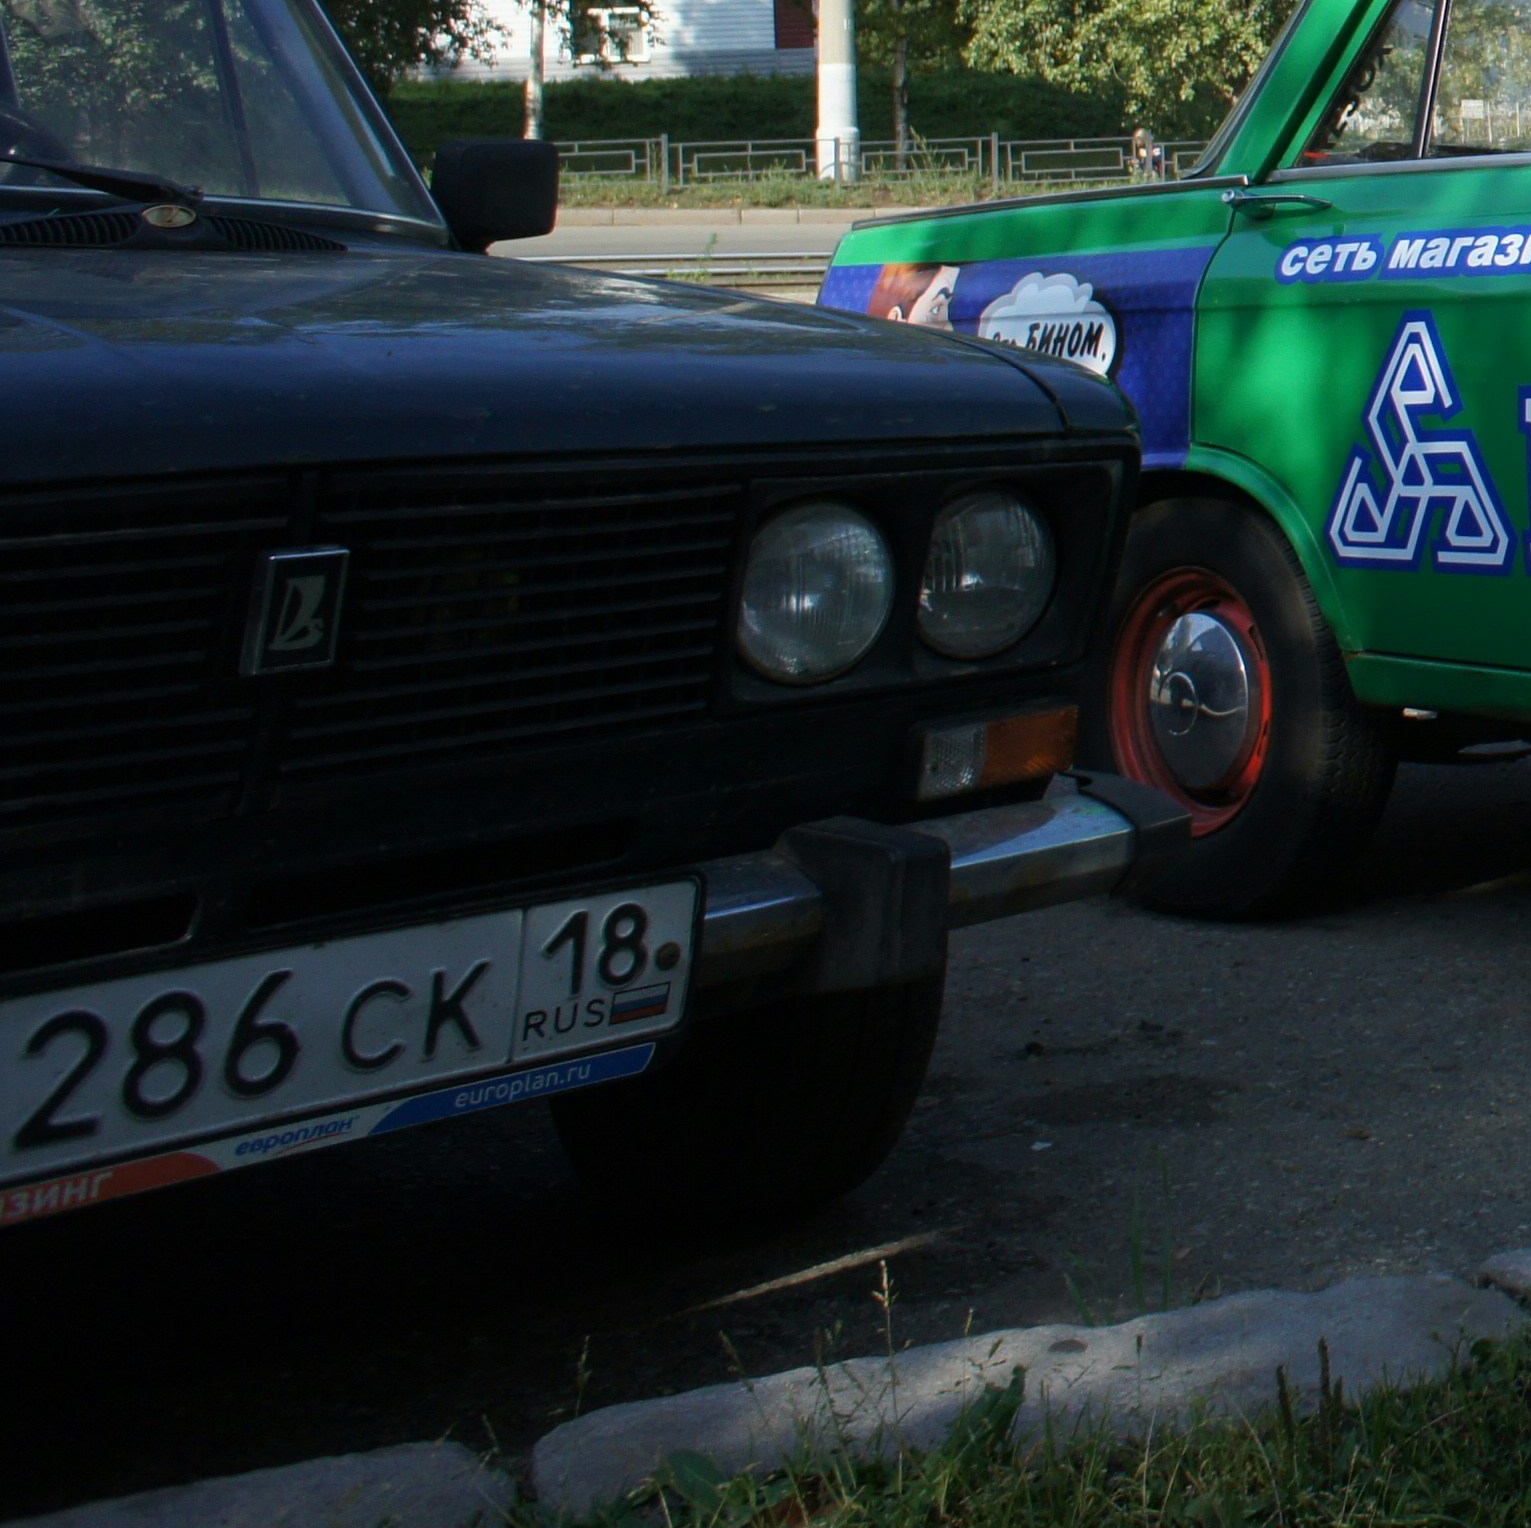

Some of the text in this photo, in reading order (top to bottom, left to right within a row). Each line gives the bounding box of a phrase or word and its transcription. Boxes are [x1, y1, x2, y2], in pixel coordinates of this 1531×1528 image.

[1281, 239, 1379, 276] сеть
[541, 901, 649, 998] 18
[521, 996, 607, 1043] RUS
[454, 1063, 592, 1109] europlan.ru
